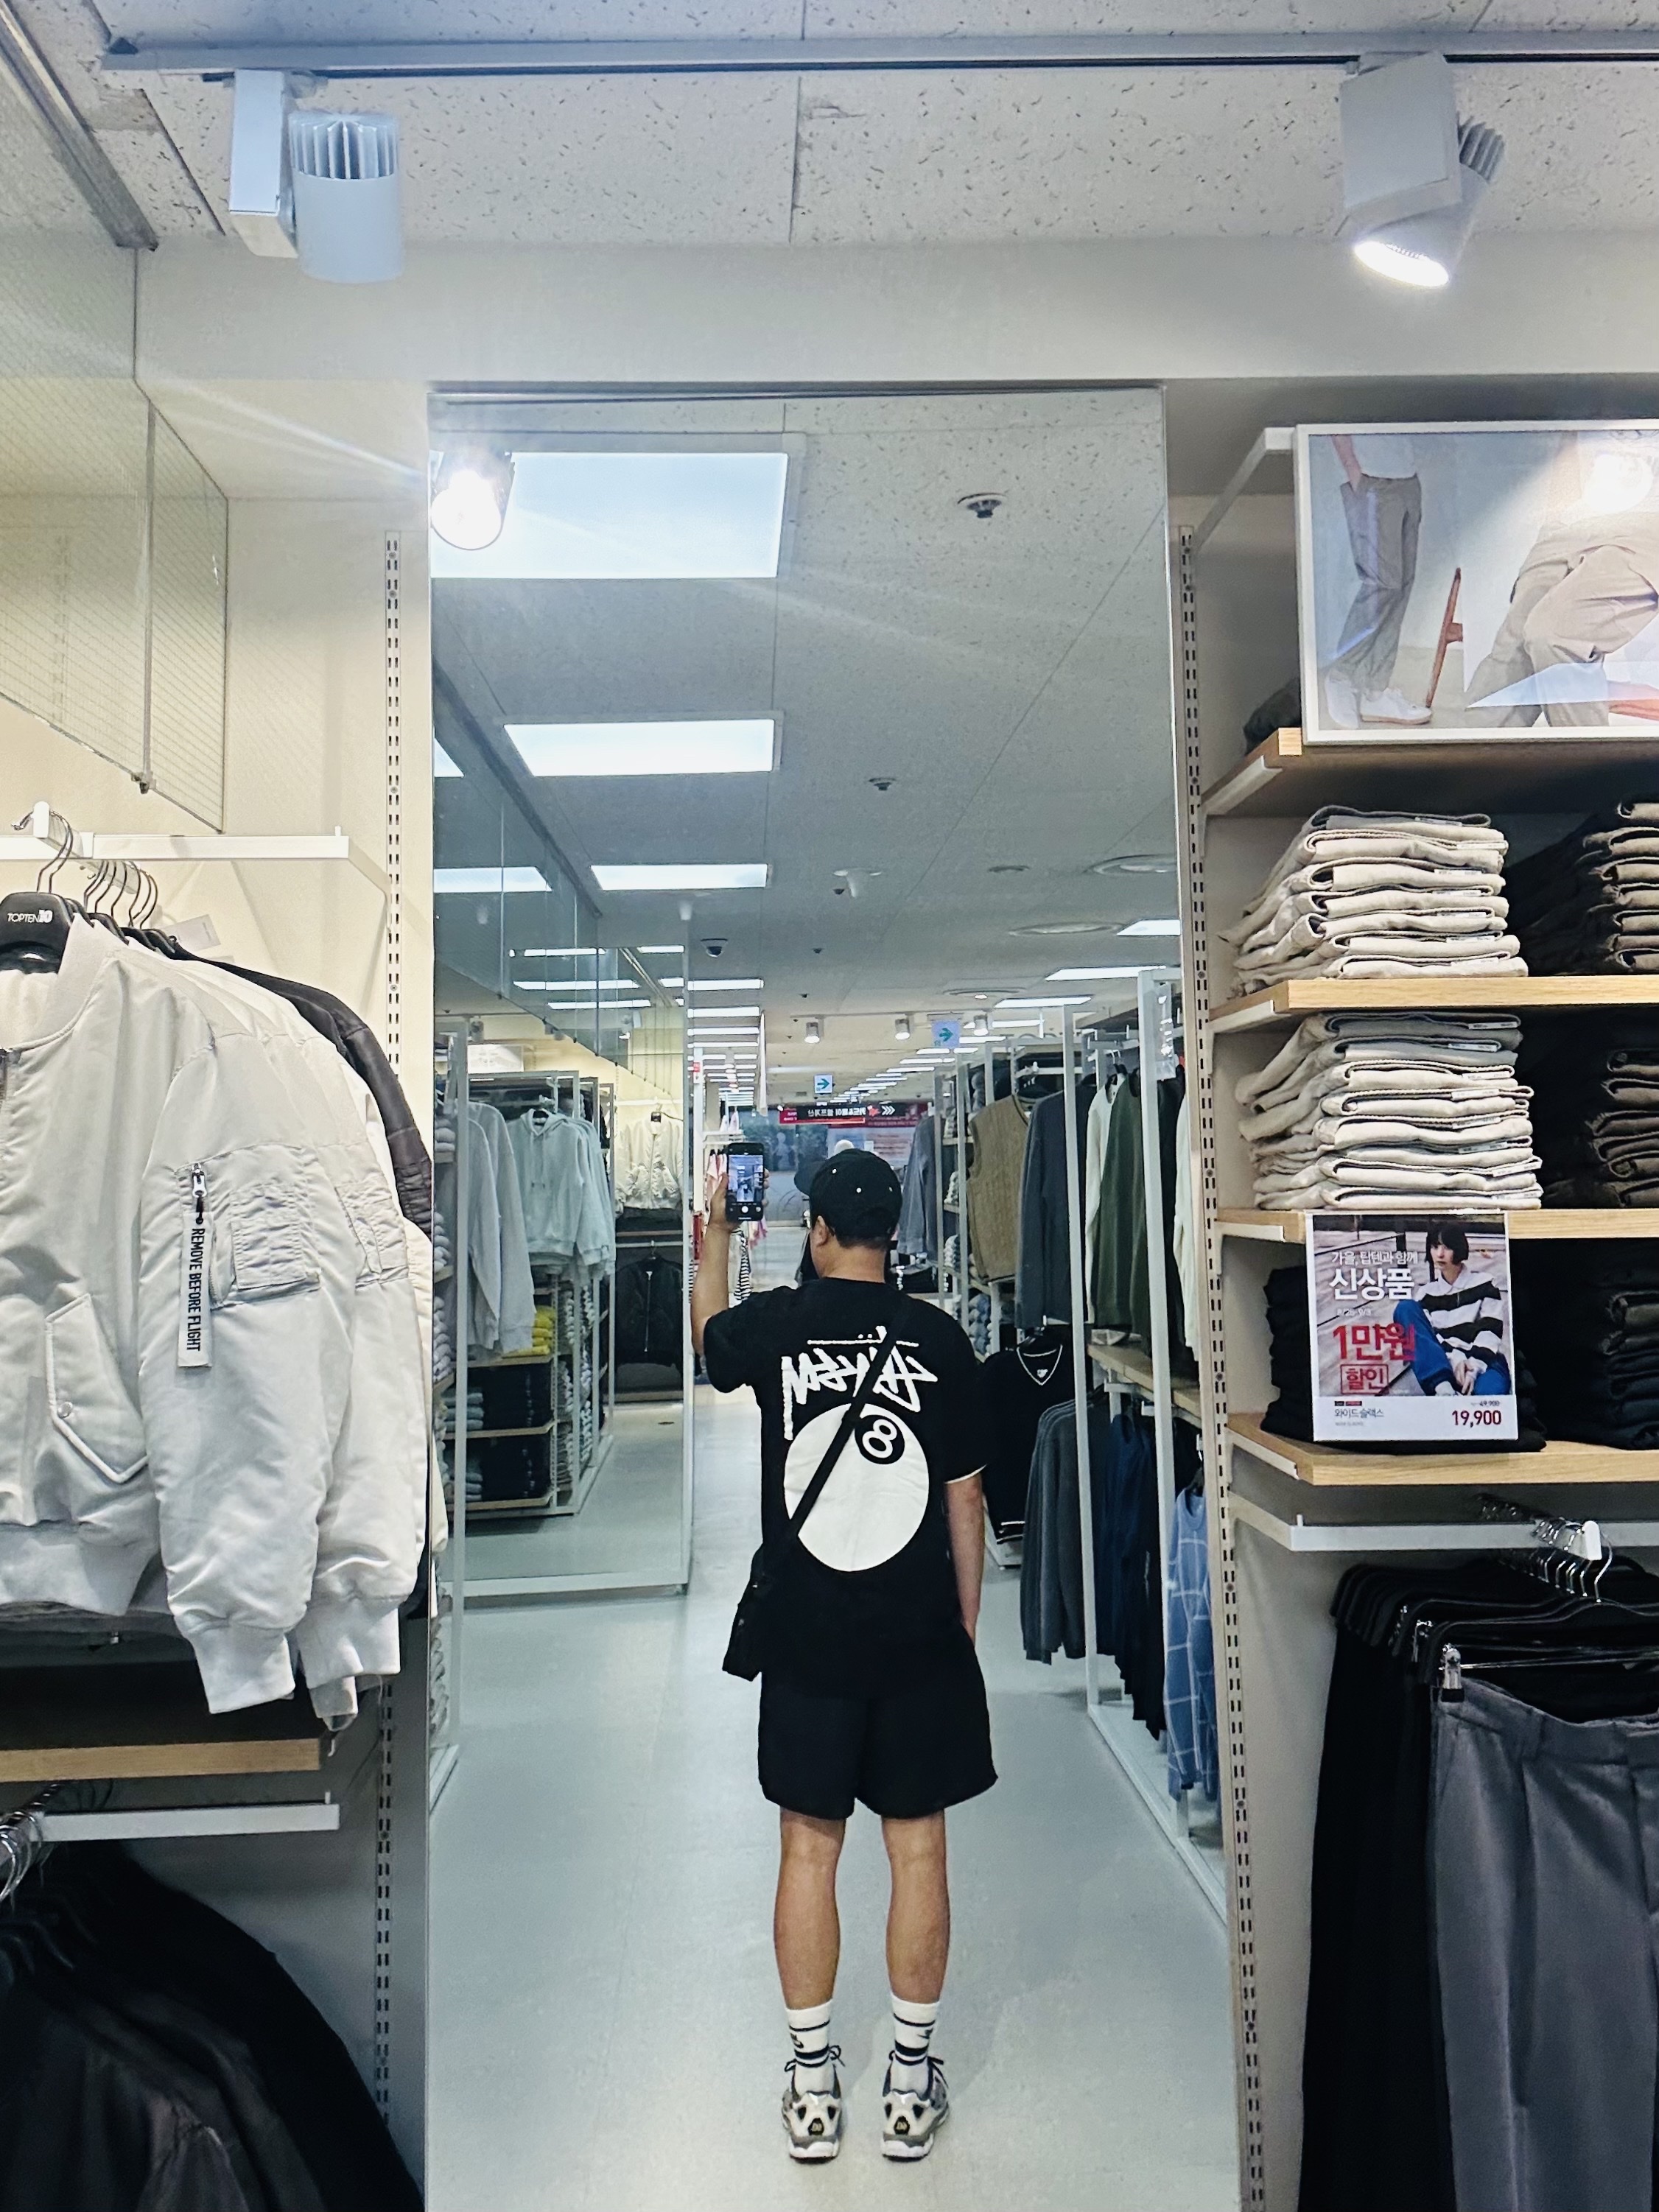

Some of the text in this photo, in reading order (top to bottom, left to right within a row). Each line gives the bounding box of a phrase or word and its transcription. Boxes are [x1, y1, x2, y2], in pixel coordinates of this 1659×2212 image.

[186, 1228, 206, 1352] REMOVE BEFORE FLIGHT
[1329, 1268, 1414, 1300] 신상품
[1333, 1323, 1415, 1360] 1만원
[1345, 1368, 1383, 1390] 할인
[1452, 1410, 1501, 1428] 19,900
